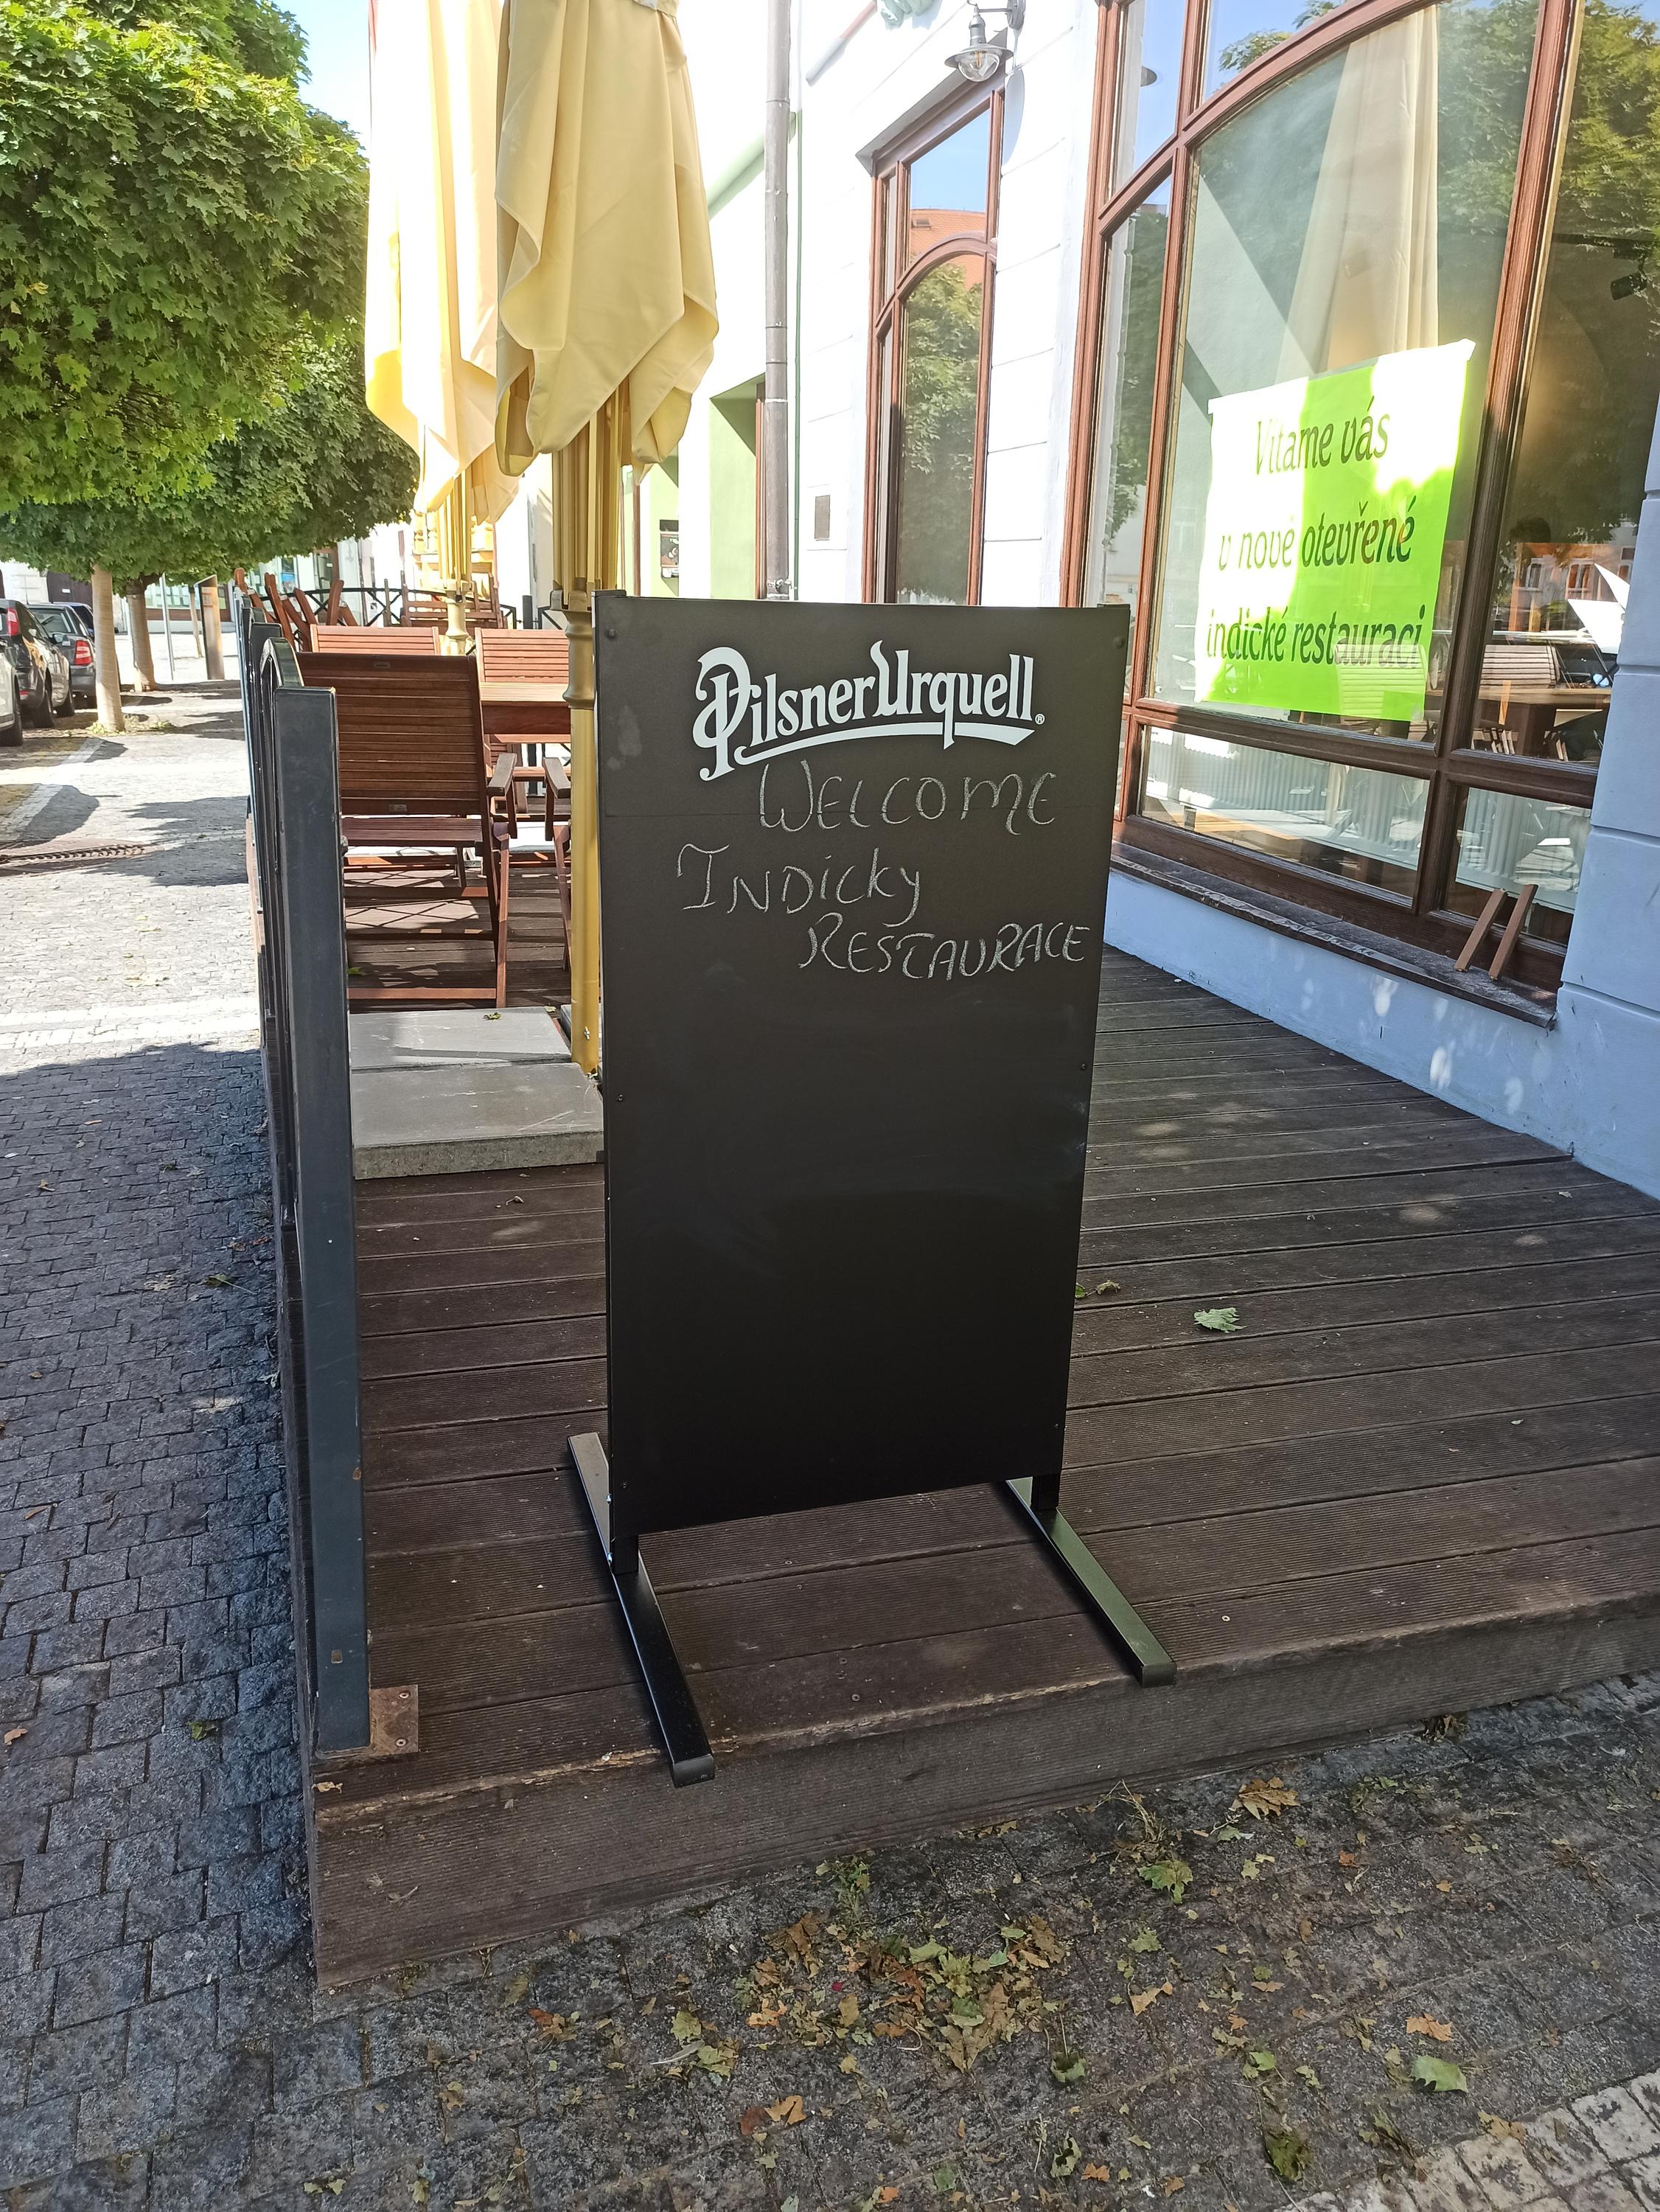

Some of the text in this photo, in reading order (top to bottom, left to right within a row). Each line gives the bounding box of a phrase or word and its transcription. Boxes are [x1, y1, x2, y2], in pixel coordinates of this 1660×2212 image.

[1340, 396, 1391, 467] vás
[1218, 531, 1232, 571] v
[1301, 495, 1417, 568] otevřené
[1206, 604, 1426, 669] indické restauraci
[692, 646, 878, 782] Pilsner
[758, 759, 1057, 835] WELCOME
[798, 911, 1090, 981] RESTAURACE
